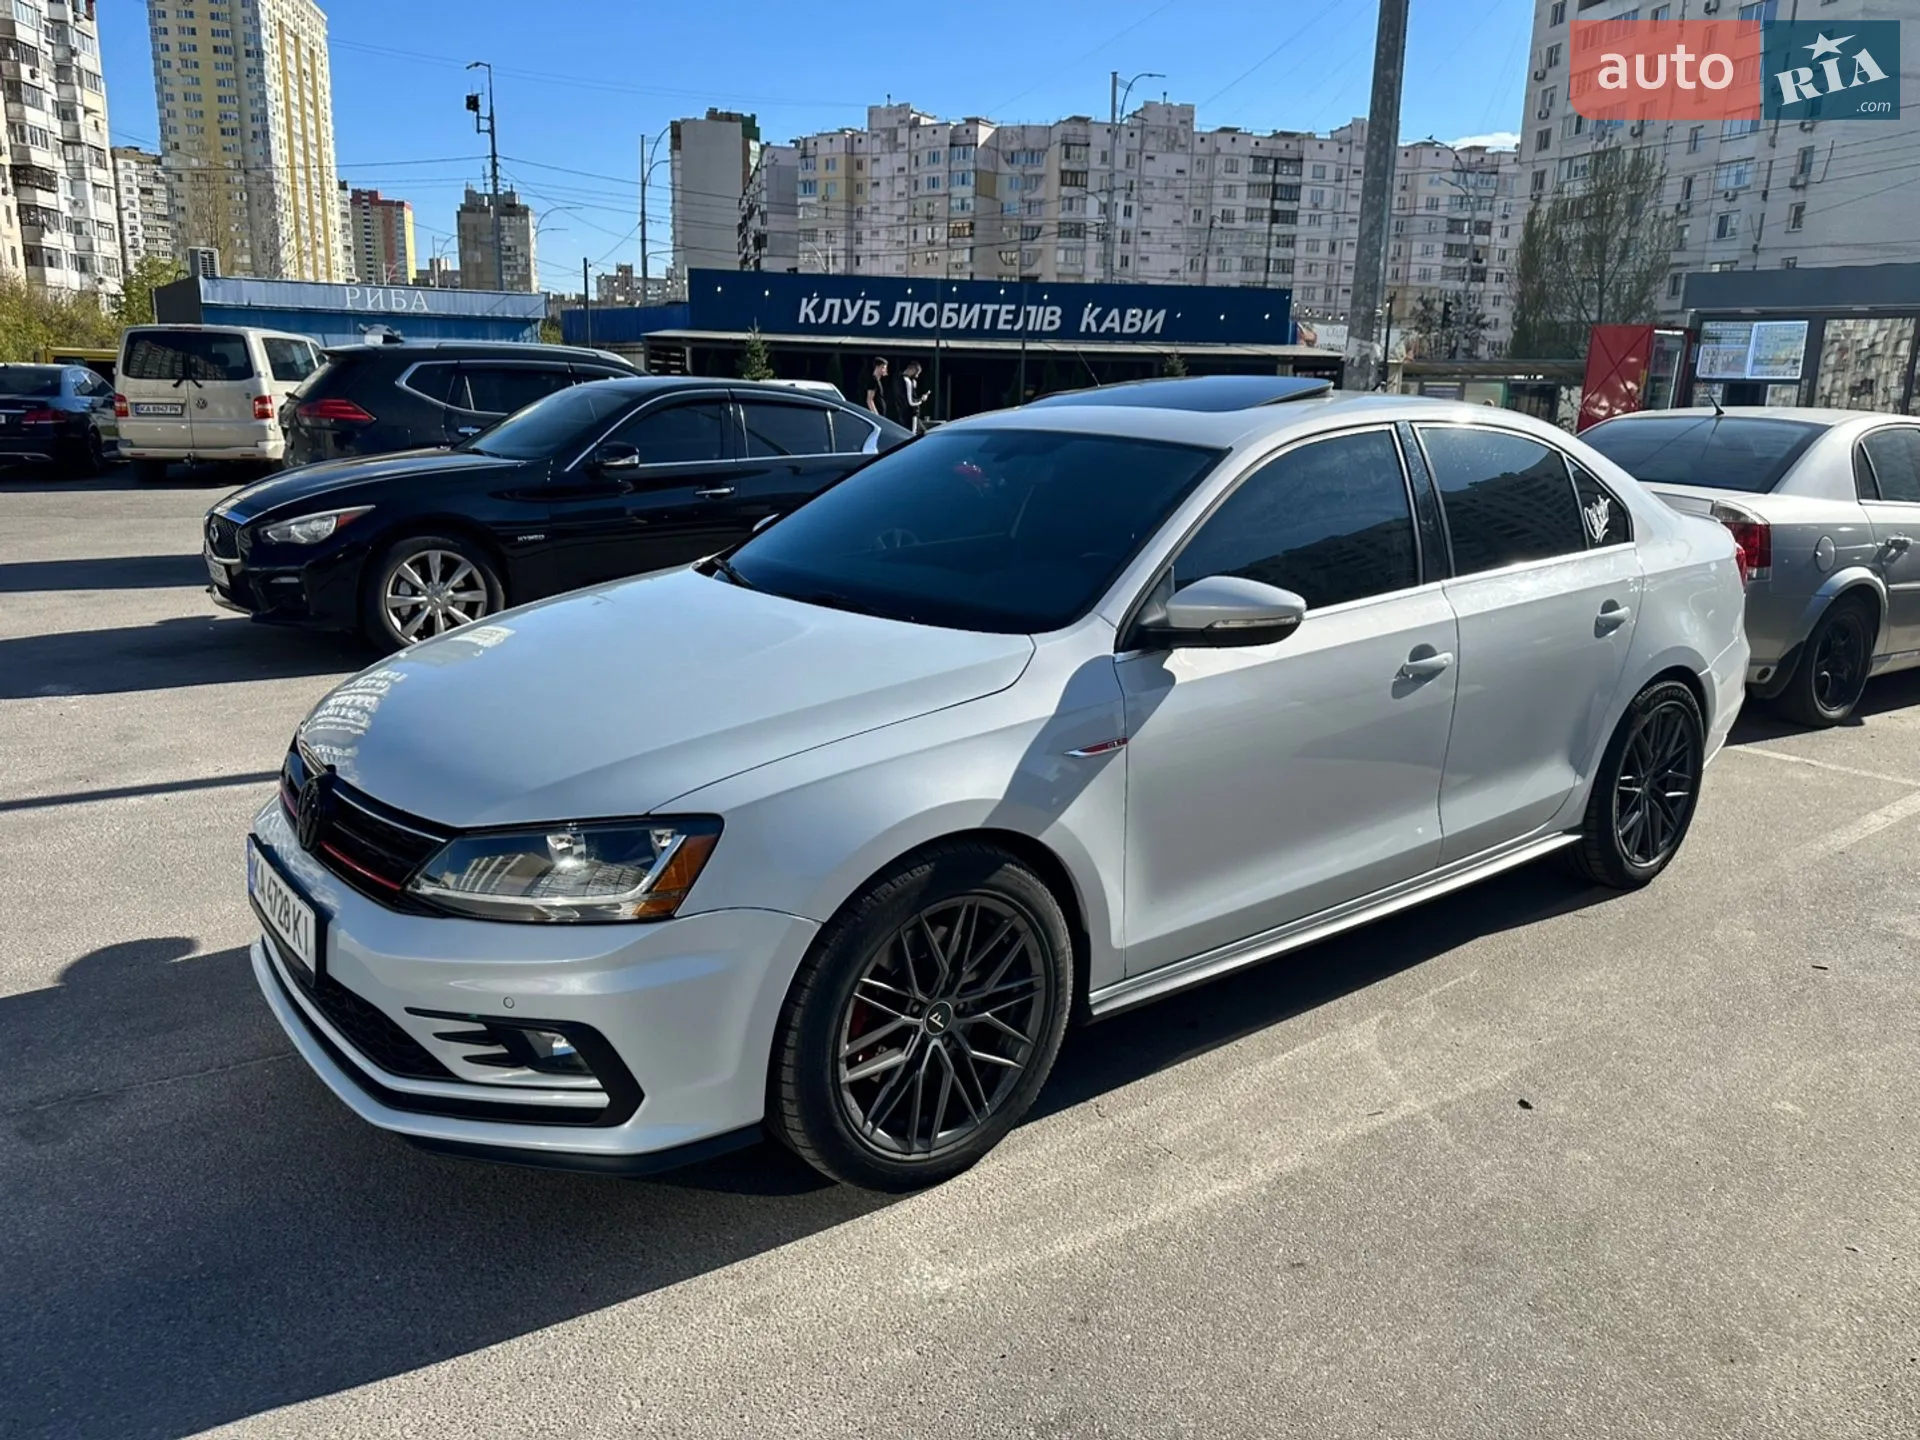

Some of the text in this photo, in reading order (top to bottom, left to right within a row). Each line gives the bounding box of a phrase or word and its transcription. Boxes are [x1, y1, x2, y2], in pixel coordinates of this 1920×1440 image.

[344, 286, 430, 312] РИБА
[798, 297, 1167, 334] КЛУБ ЛЮБИТЕЛІВ КАВИ
[267, 875, 291, 934] 4728
